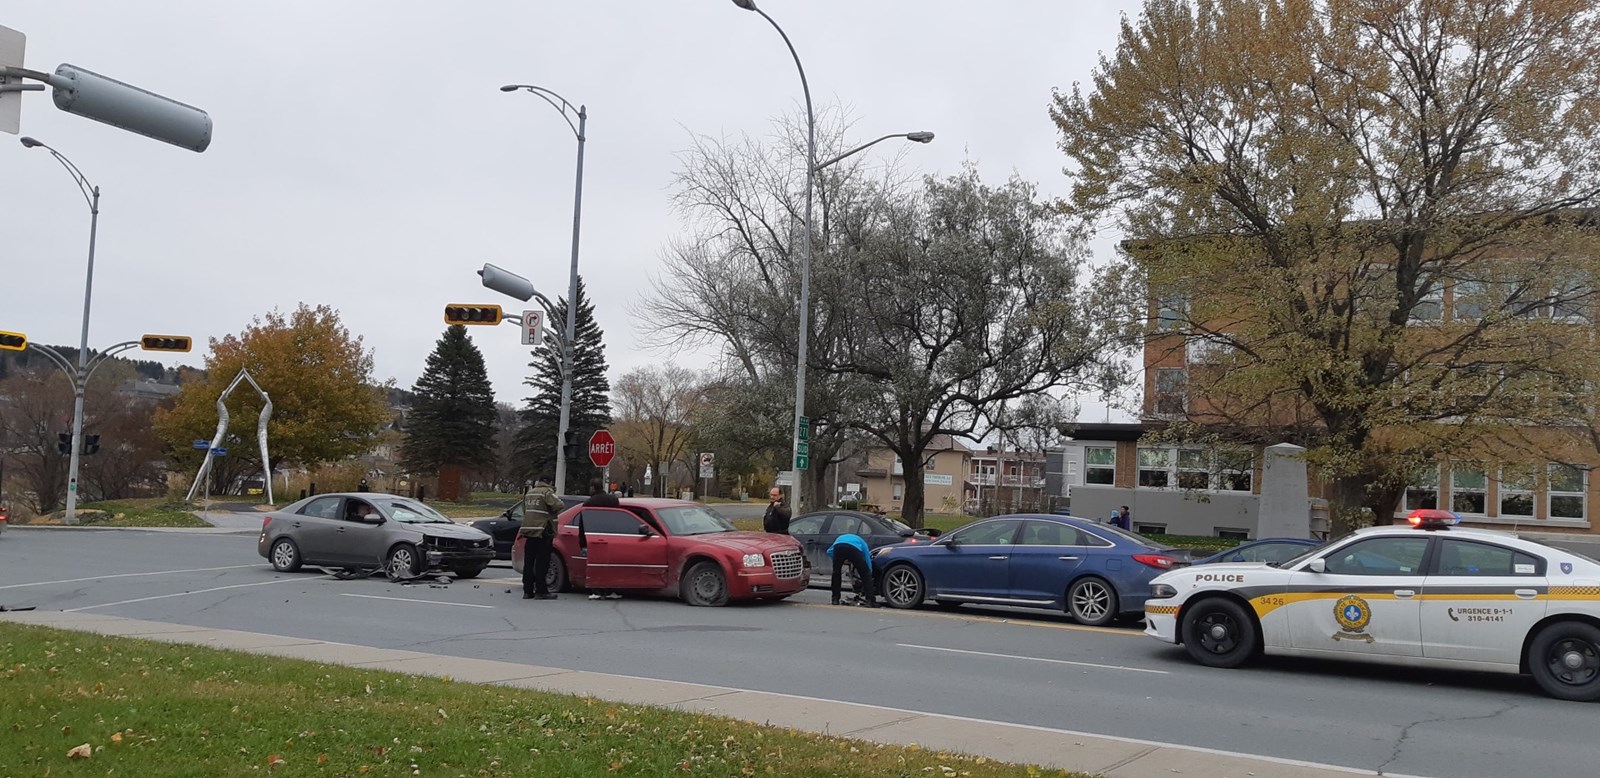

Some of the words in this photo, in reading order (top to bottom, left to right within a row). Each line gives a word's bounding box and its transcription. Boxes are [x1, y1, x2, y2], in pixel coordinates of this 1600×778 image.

[591, 441, 614, 454] ARRÊT
[797, 444, 807, 454] SUD
[1195, 574, 1244, 583] POLICE
